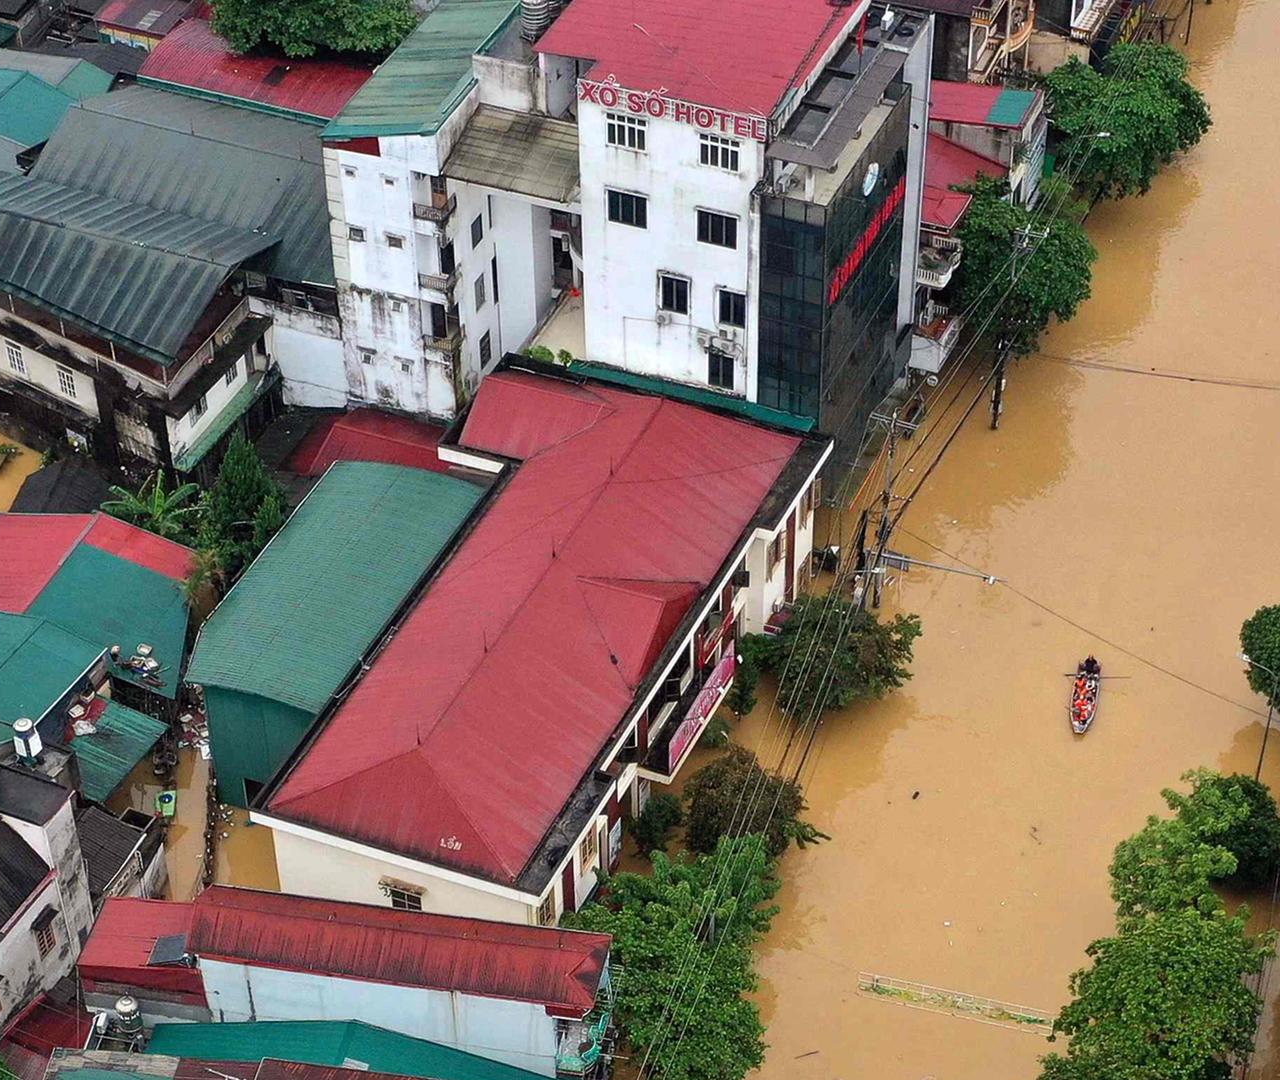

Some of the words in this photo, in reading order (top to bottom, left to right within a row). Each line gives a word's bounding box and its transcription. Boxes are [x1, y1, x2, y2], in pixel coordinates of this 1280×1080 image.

[579, 74, 620, 109] XỔ
[627, 87, 669, 118] SỐ
[675, 102, 766, 142] HOTEL
